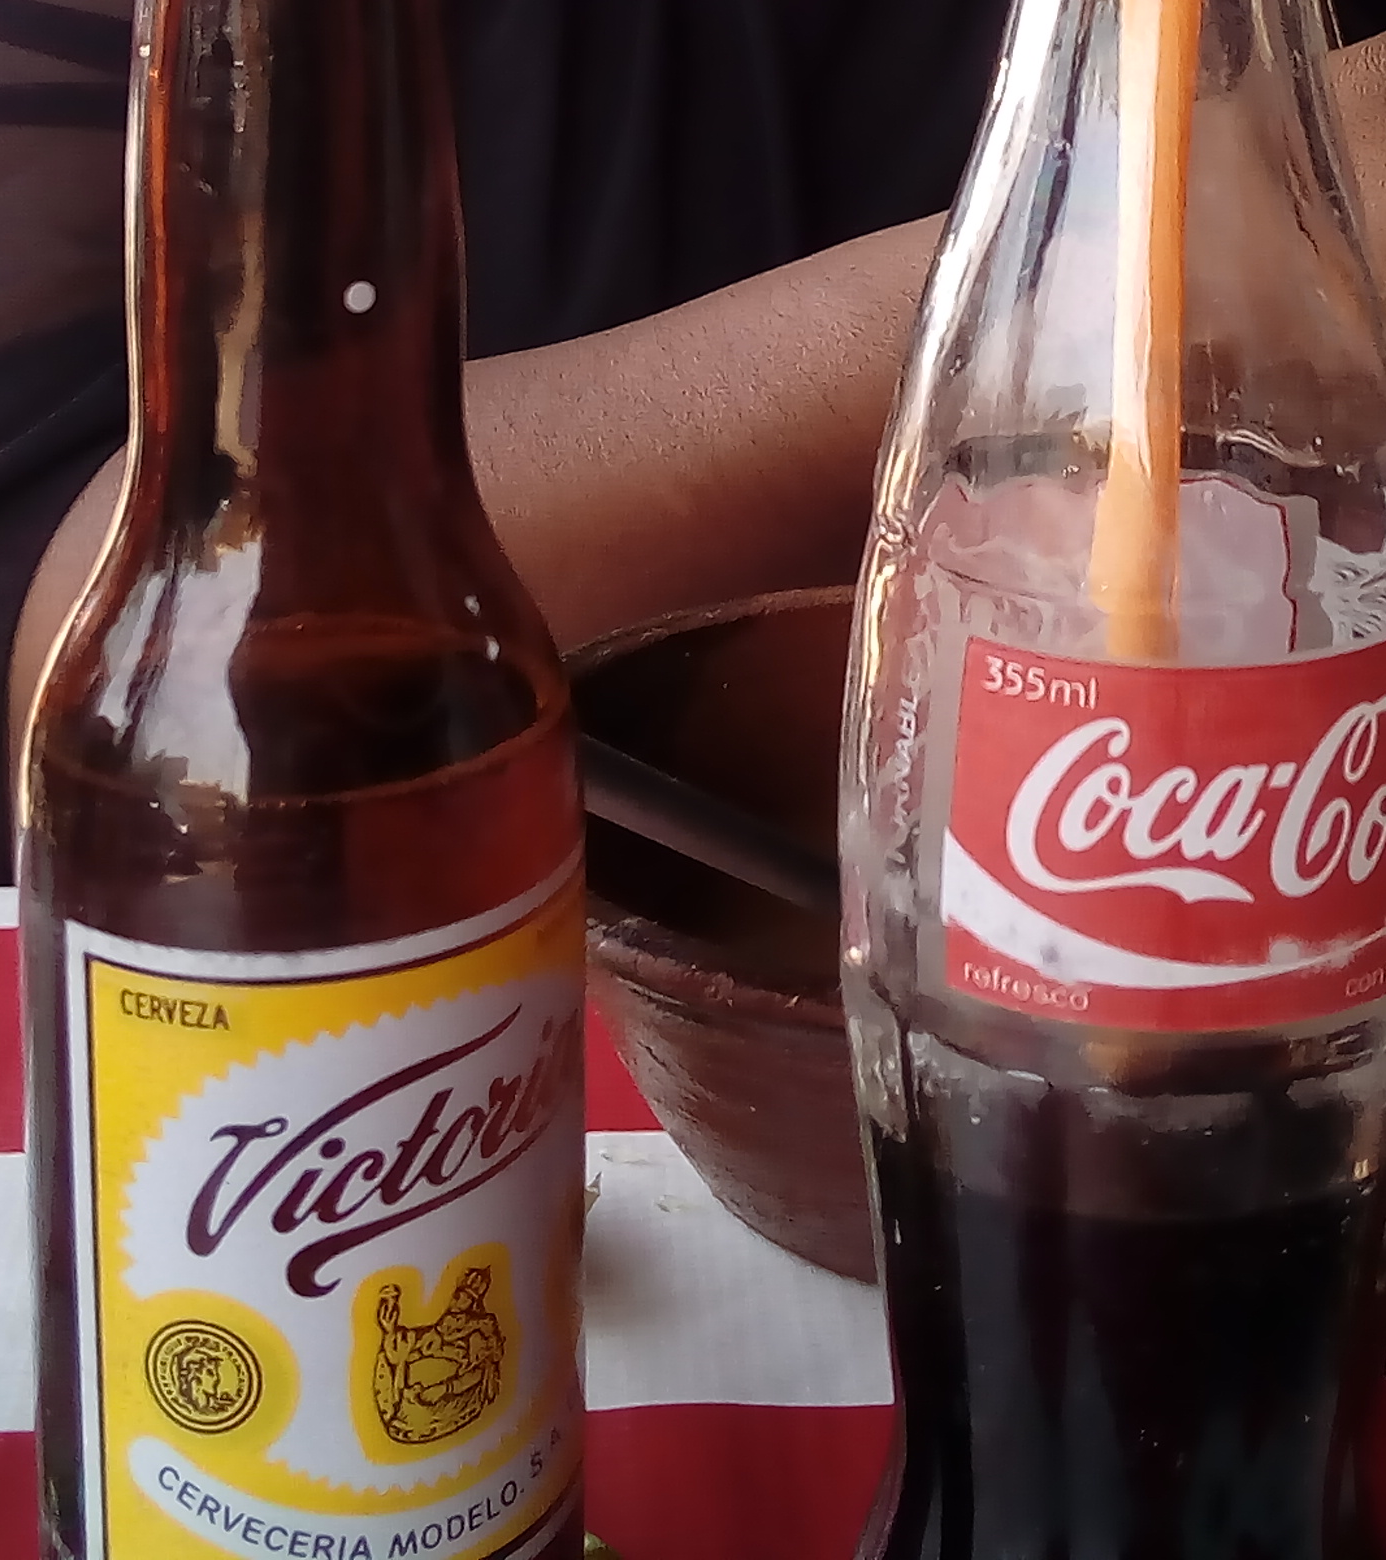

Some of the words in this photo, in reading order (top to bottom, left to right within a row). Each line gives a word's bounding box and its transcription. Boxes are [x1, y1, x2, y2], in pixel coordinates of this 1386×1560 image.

[982, 654, 1099, 709] 355ml
[120, 988, 230, 1032] CERVEZA
[964, 961, 1093, 1011] refresco
[158, 1465, 373, 1560] CERVECERIA
